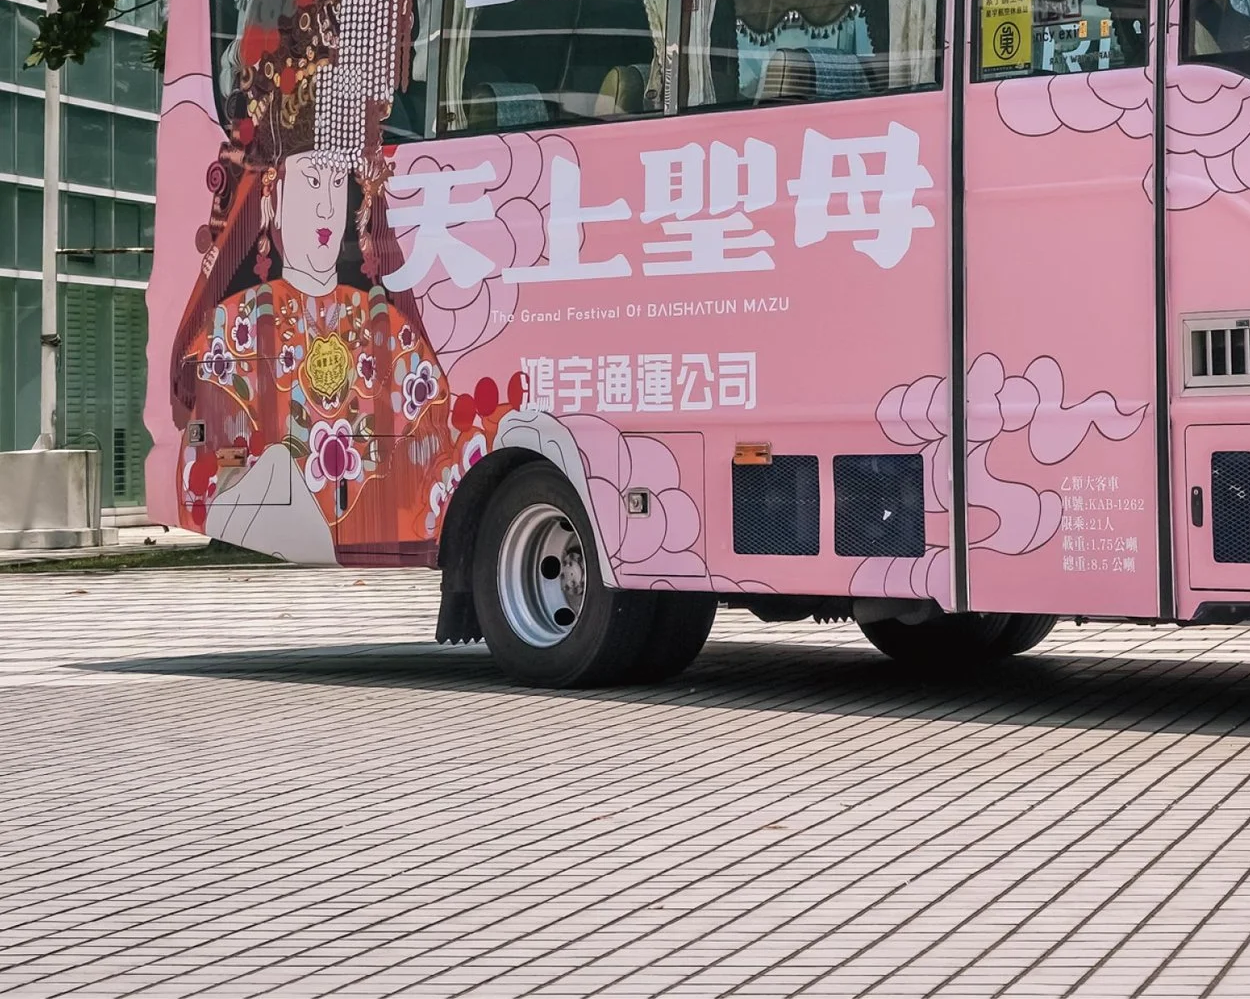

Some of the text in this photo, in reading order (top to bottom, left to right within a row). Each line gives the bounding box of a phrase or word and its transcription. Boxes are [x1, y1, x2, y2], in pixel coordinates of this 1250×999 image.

[382, 120, 936, 292] 天上聖母
[491, 297, 790, 323] The Grand Festival Of BAISHATUN MAZU
[520, 352, 757, 412] 鴻宇通運公司
